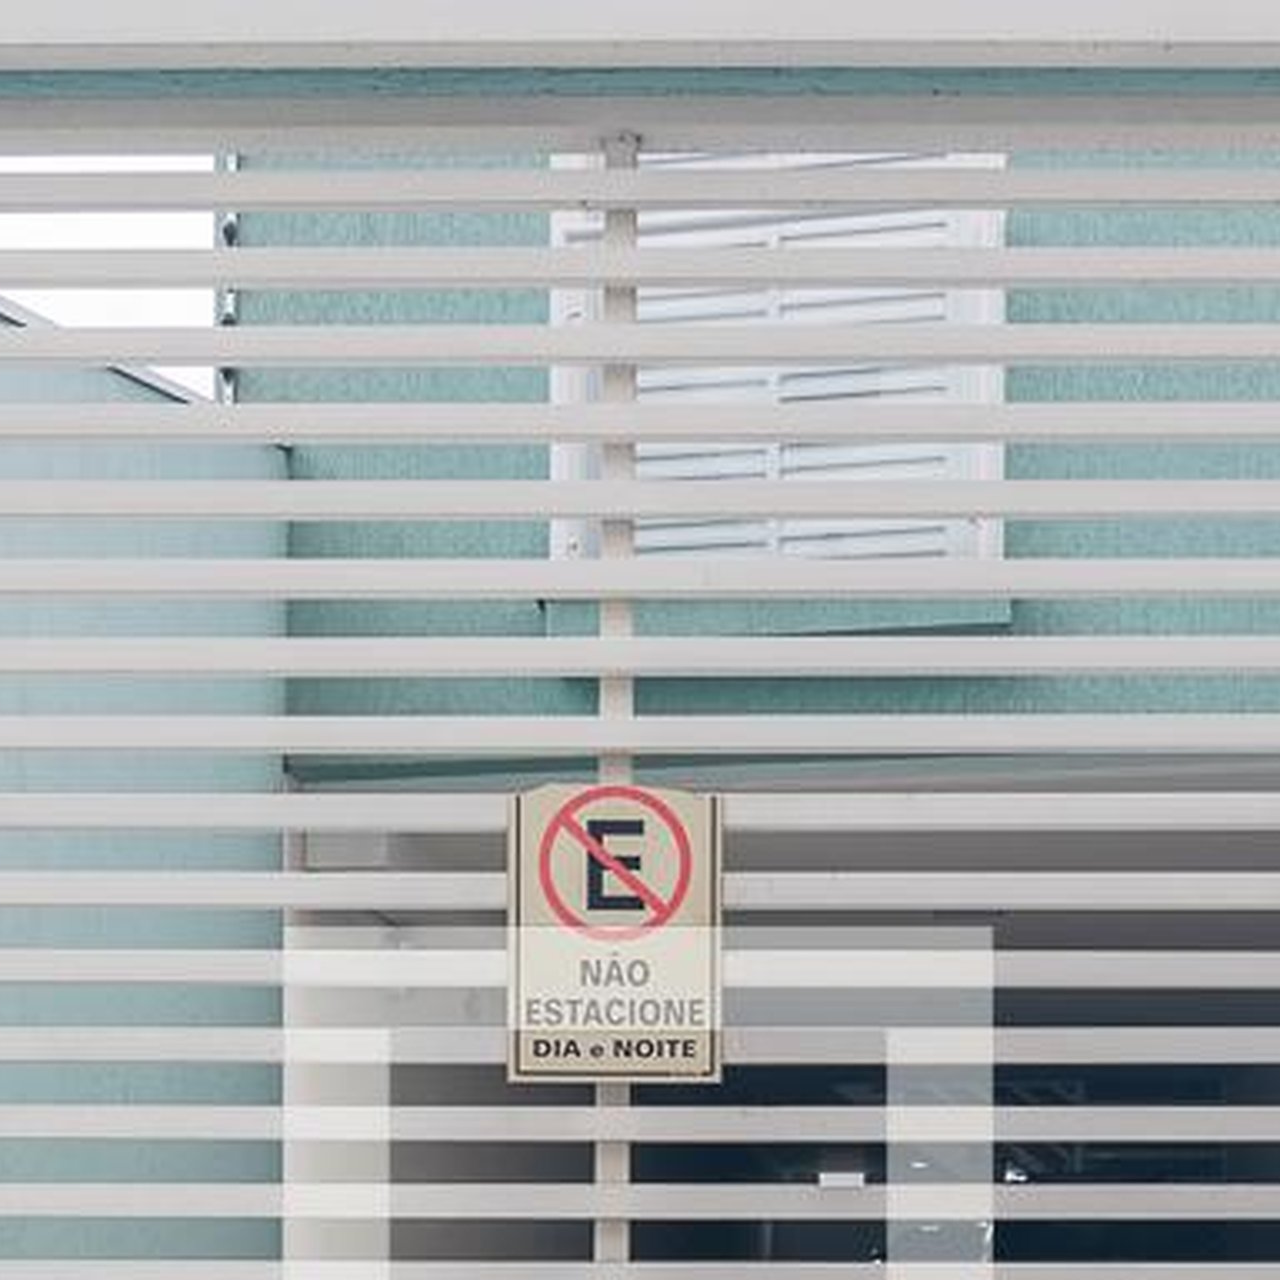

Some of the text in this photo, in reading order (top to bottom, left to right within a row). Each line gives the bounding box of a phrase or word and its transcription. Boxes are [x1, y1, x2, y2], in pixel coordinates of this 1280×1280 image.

[586, 820, 645, 910] E
[579, 950, 650, 987] NÃO
[525, 998, 705, 1026] ESTACIONE
[533, 1039, 697, 1058] DIA e NOITE
